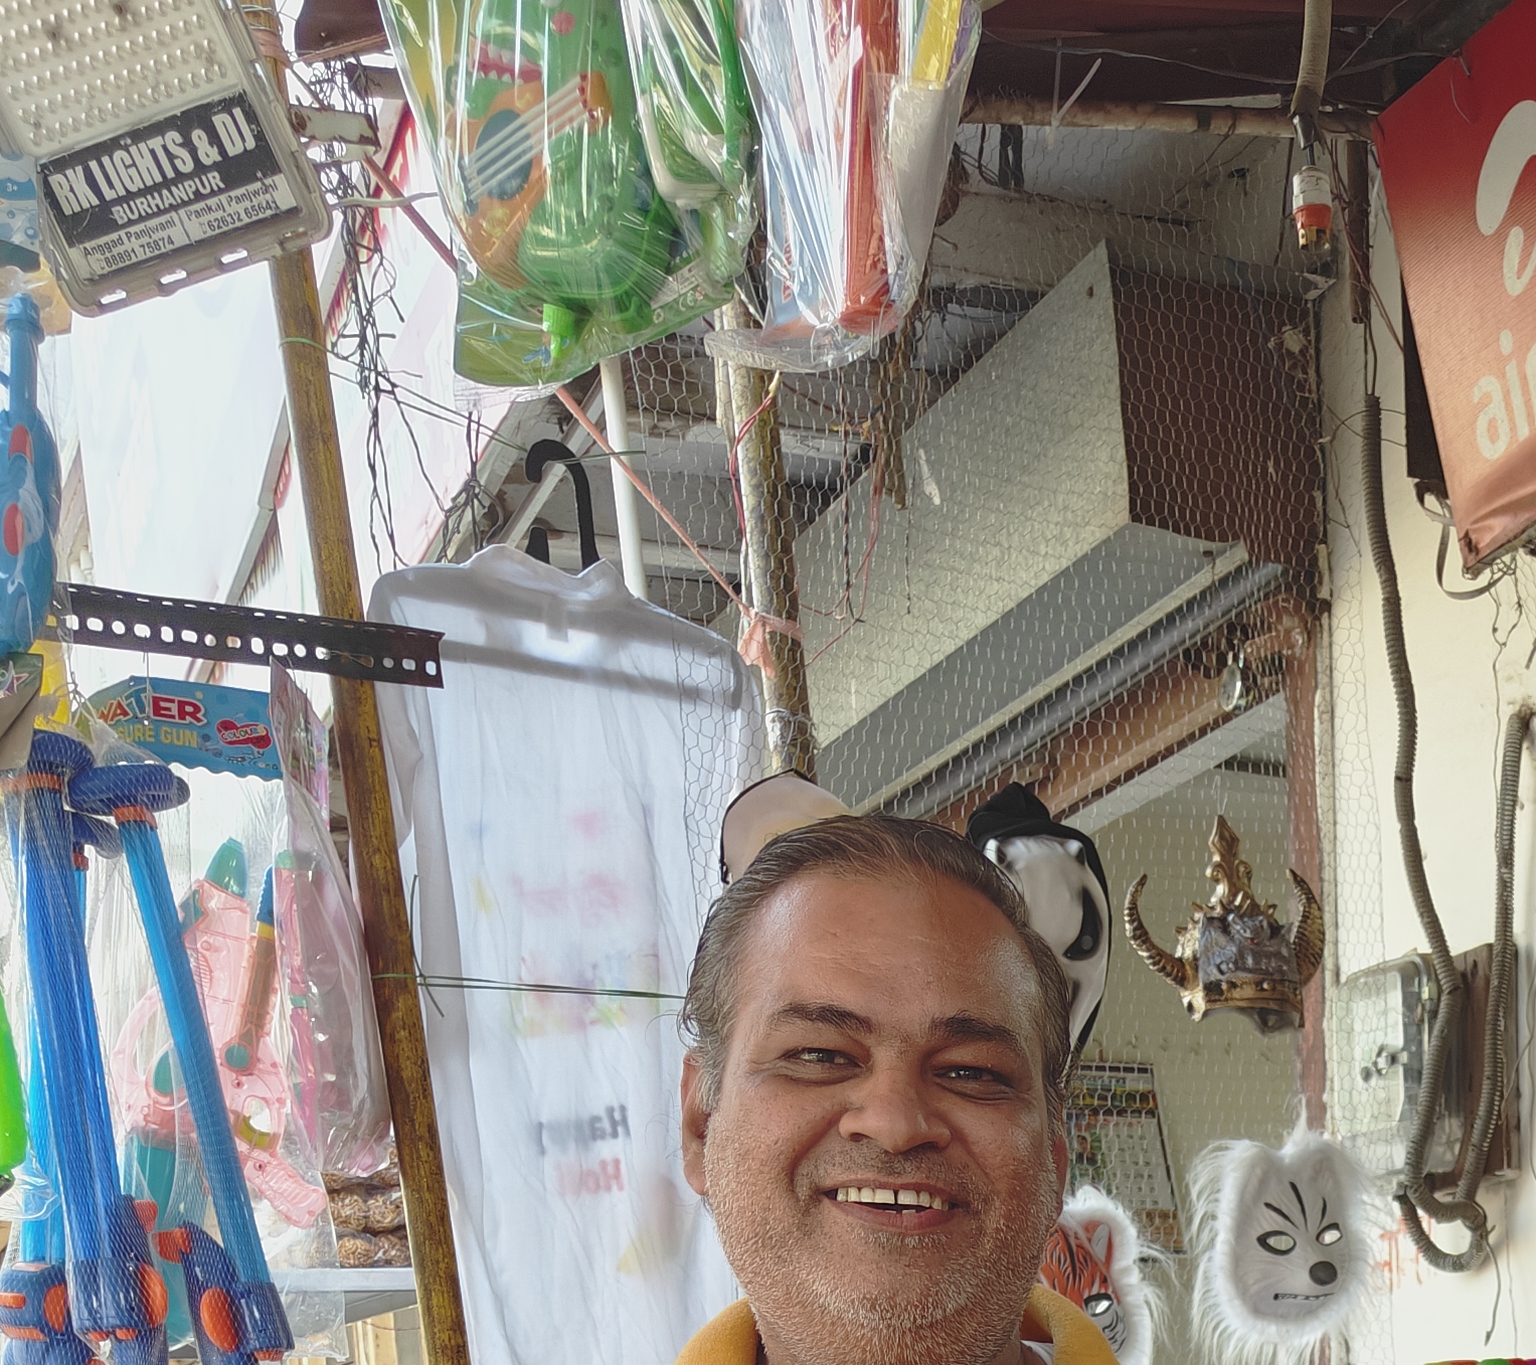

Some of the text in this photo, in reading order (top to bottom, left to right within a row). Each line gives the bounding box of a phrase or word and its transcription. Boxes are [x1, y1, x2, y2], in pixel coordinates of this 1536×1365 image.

[47, 107, 257, 216] RK LIGHTS & DJ
[111, 171, 225, 225] BURHANPUR
[185, 198, 227, 222] Pankaj
[125, 216, 178, 246] Panjwani
[160, 727, 198, 748] GUN
